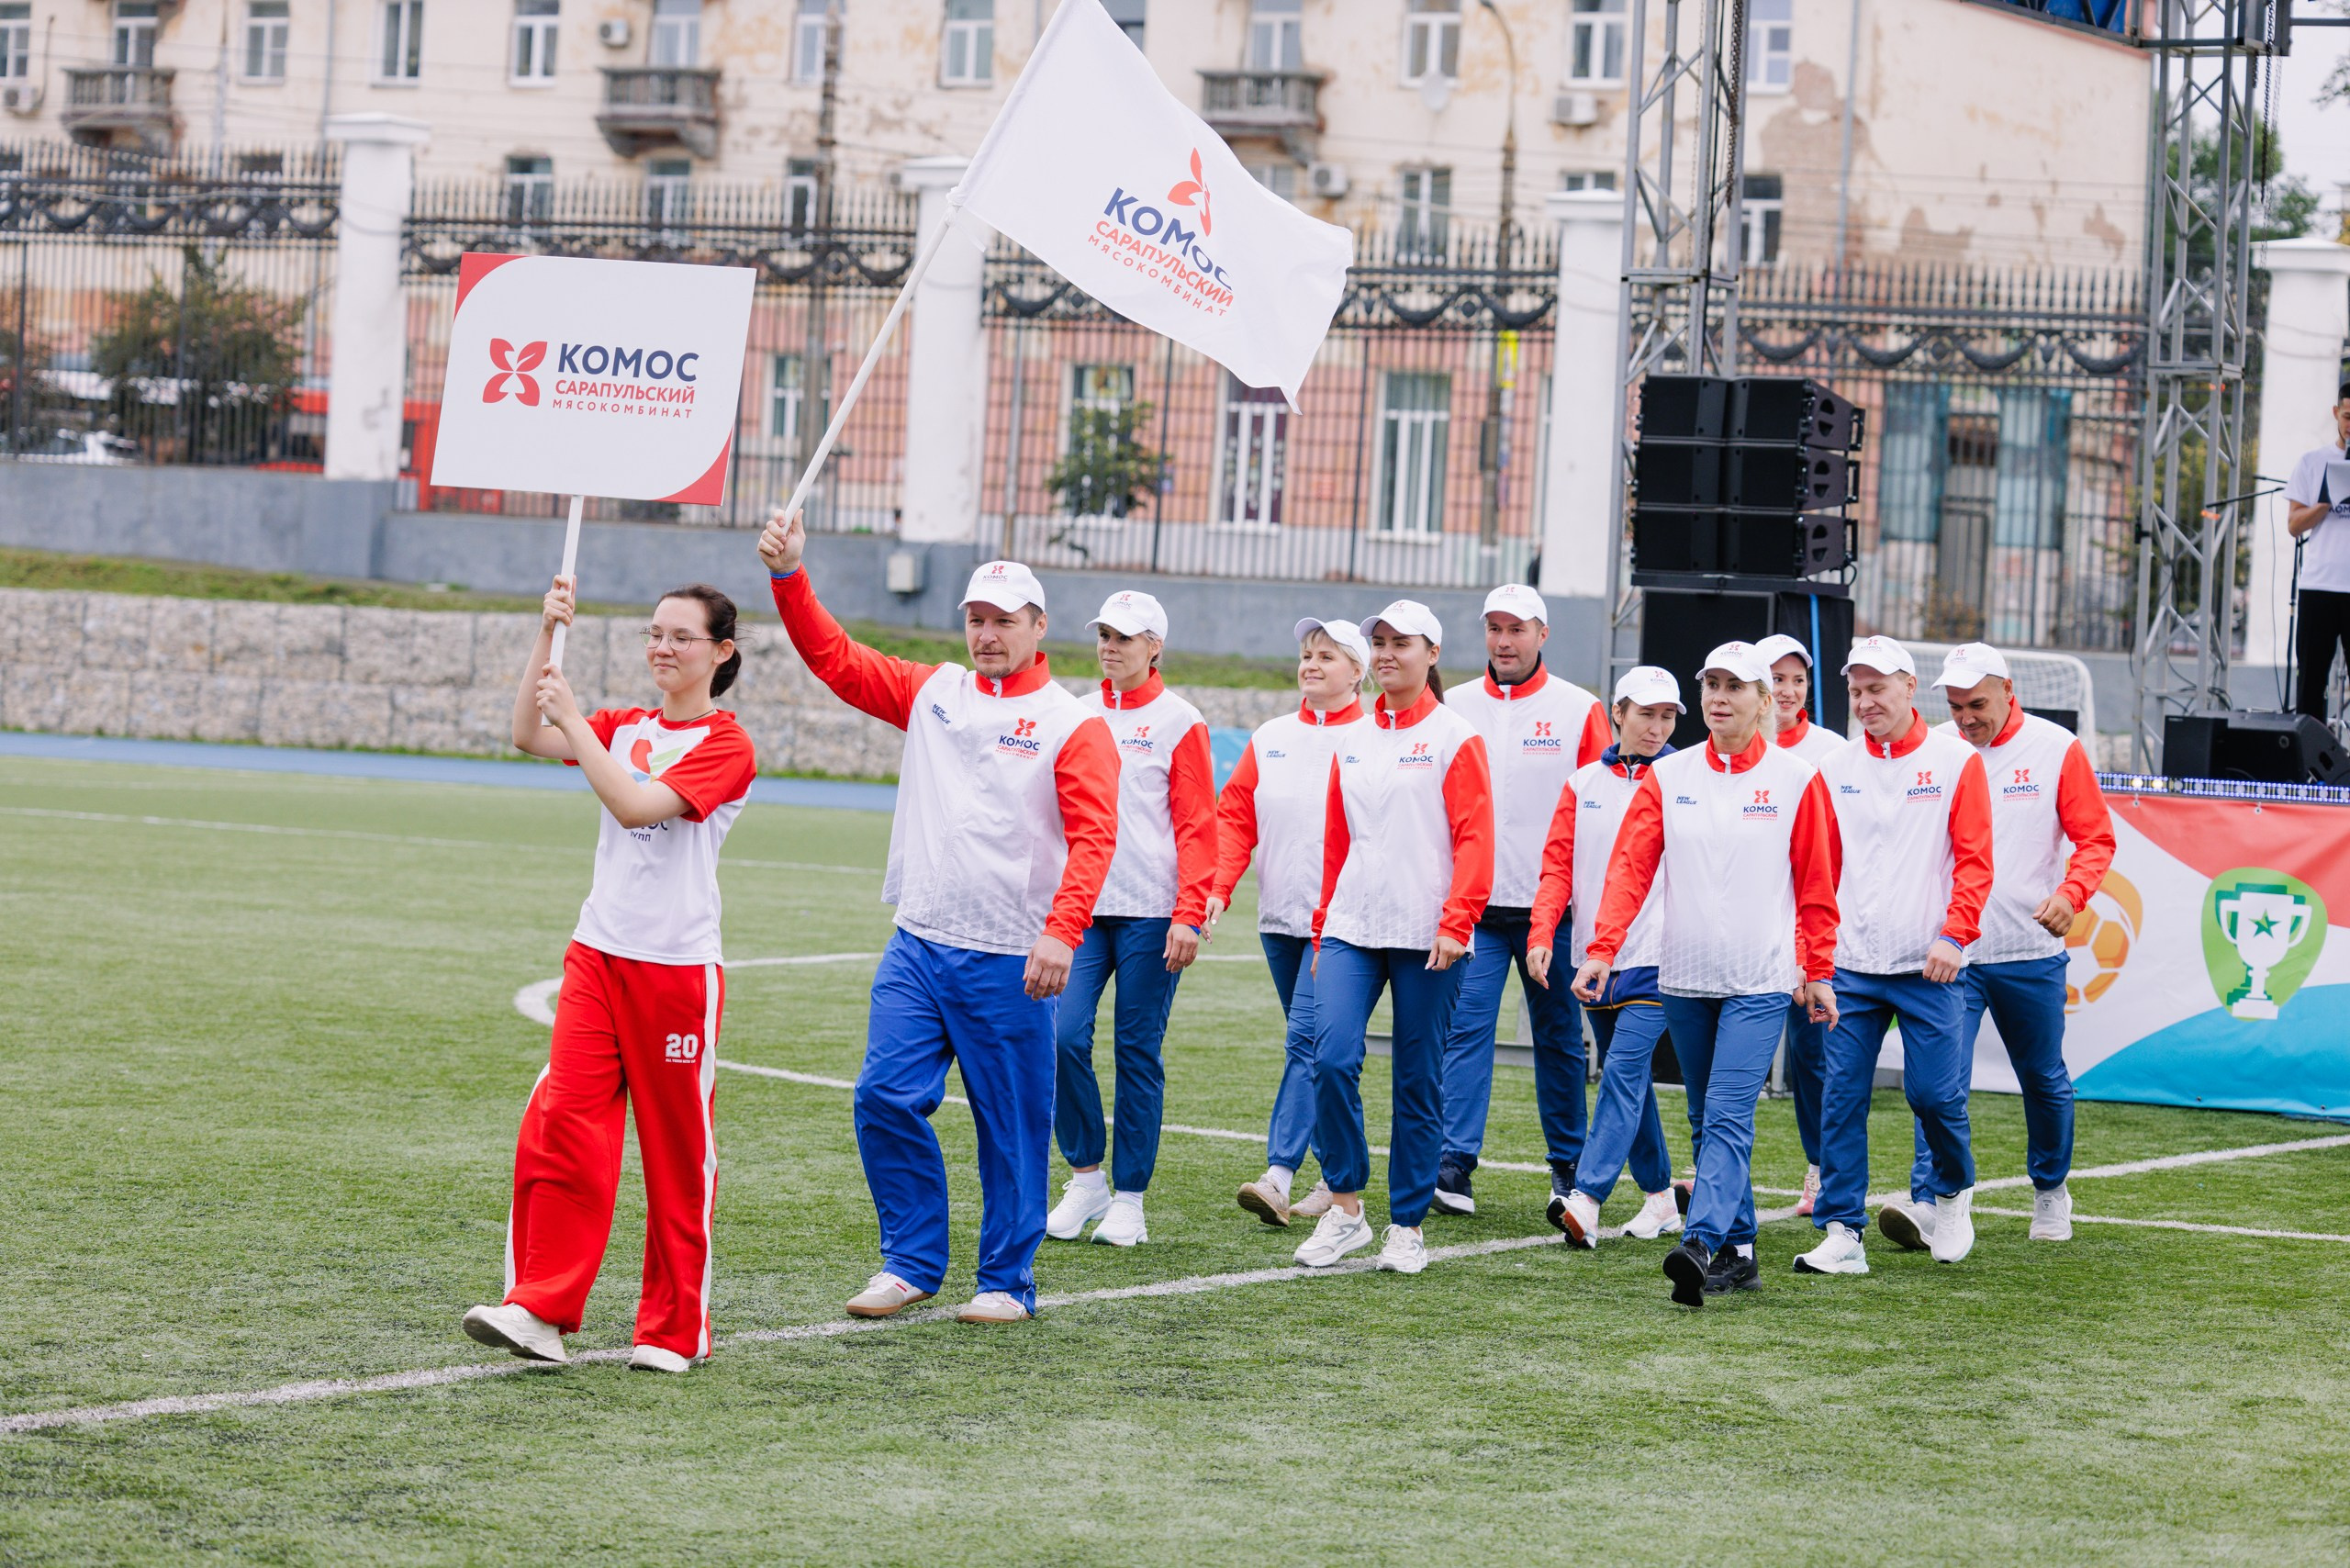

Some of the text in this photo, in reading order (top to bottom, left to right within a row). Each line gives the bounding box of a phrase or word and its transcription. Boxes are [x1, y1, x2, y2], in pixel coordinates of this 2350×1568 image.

[1103, 186, 1233, 291] КОМОС
[1096, 220, 1234, 307] САРАПУЛЬСКИЙ
[1088, 234, 1227, 317] МЯСОКОМБИНАТ
[557, 343, 699, 382] КОМОС
[554, 379, 695, 405] САРАПУЛЬСКИЙ
[553, 398, 692, 419] МЯСОКОМБИНАТ
[932, 707, 951, 725] LEAGUE
[934, 703, 946, 714] NEW
[999, 734, 1041, 751] КОМОС
[1121, 738, 1154, 749] КОМОС
[1523, 738, 1561, 746] КОМОС
[1399, 755, 1434, 763] КОМОС
[1907, 786, 1942, 796] КОМОС
[2003, 784, 2040, 794] КОМОС
[1743, 805, 1778, 813] КОМОС
[666, 1033, 699, 1058] 20
